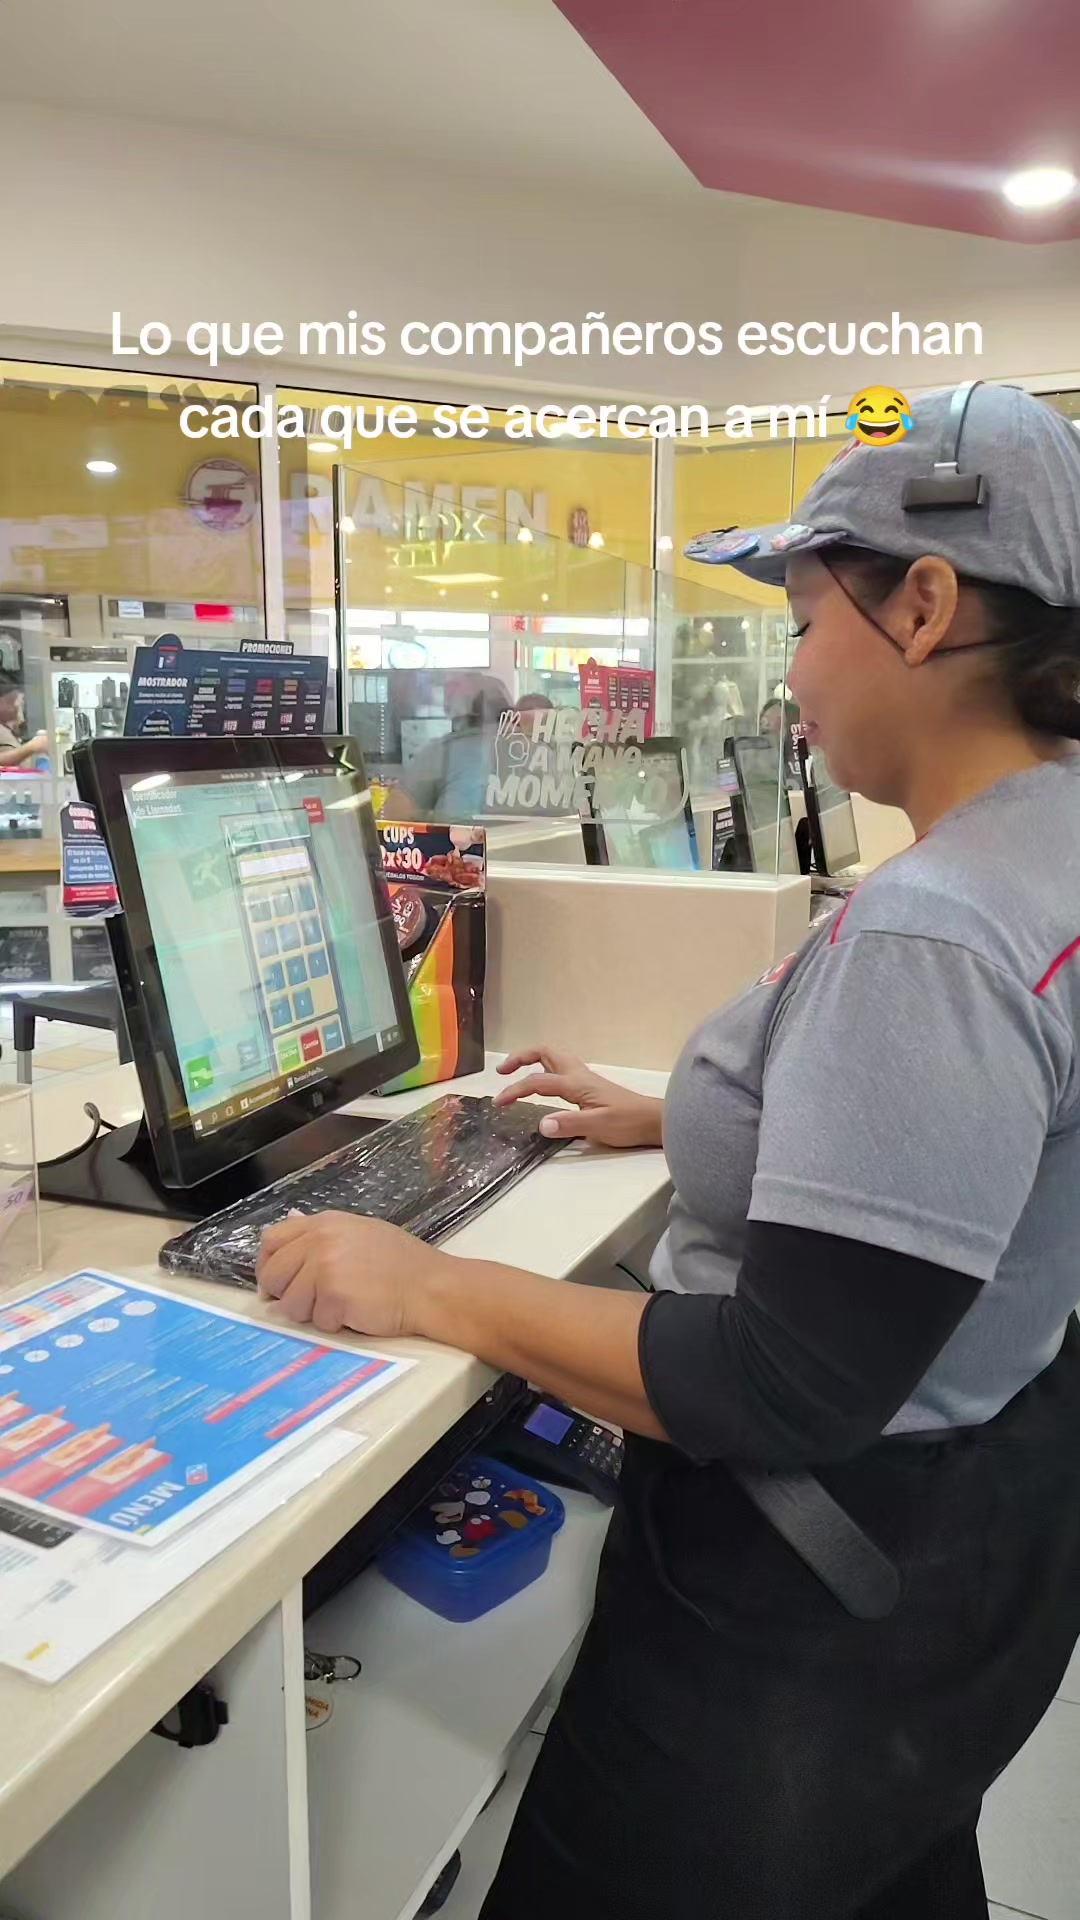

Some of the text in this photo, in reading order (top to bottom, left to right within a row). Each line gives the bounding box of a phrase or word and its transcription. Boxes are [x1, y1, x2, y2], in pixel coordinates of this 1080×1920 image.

[289, 472, 550, 545] RAMEN
[241, 642, 293, 655] PROMOCIONES
[138, 676, 188, 688] MOSTRADOR
[531, 707, 646, 744] HECHA
[528, 745, 548, 773] A
[485, 774, 669, 813] MOMENO
[383, 826, 415, 845] CUPS
[109, 1481, 186, 1527] MENÚ
